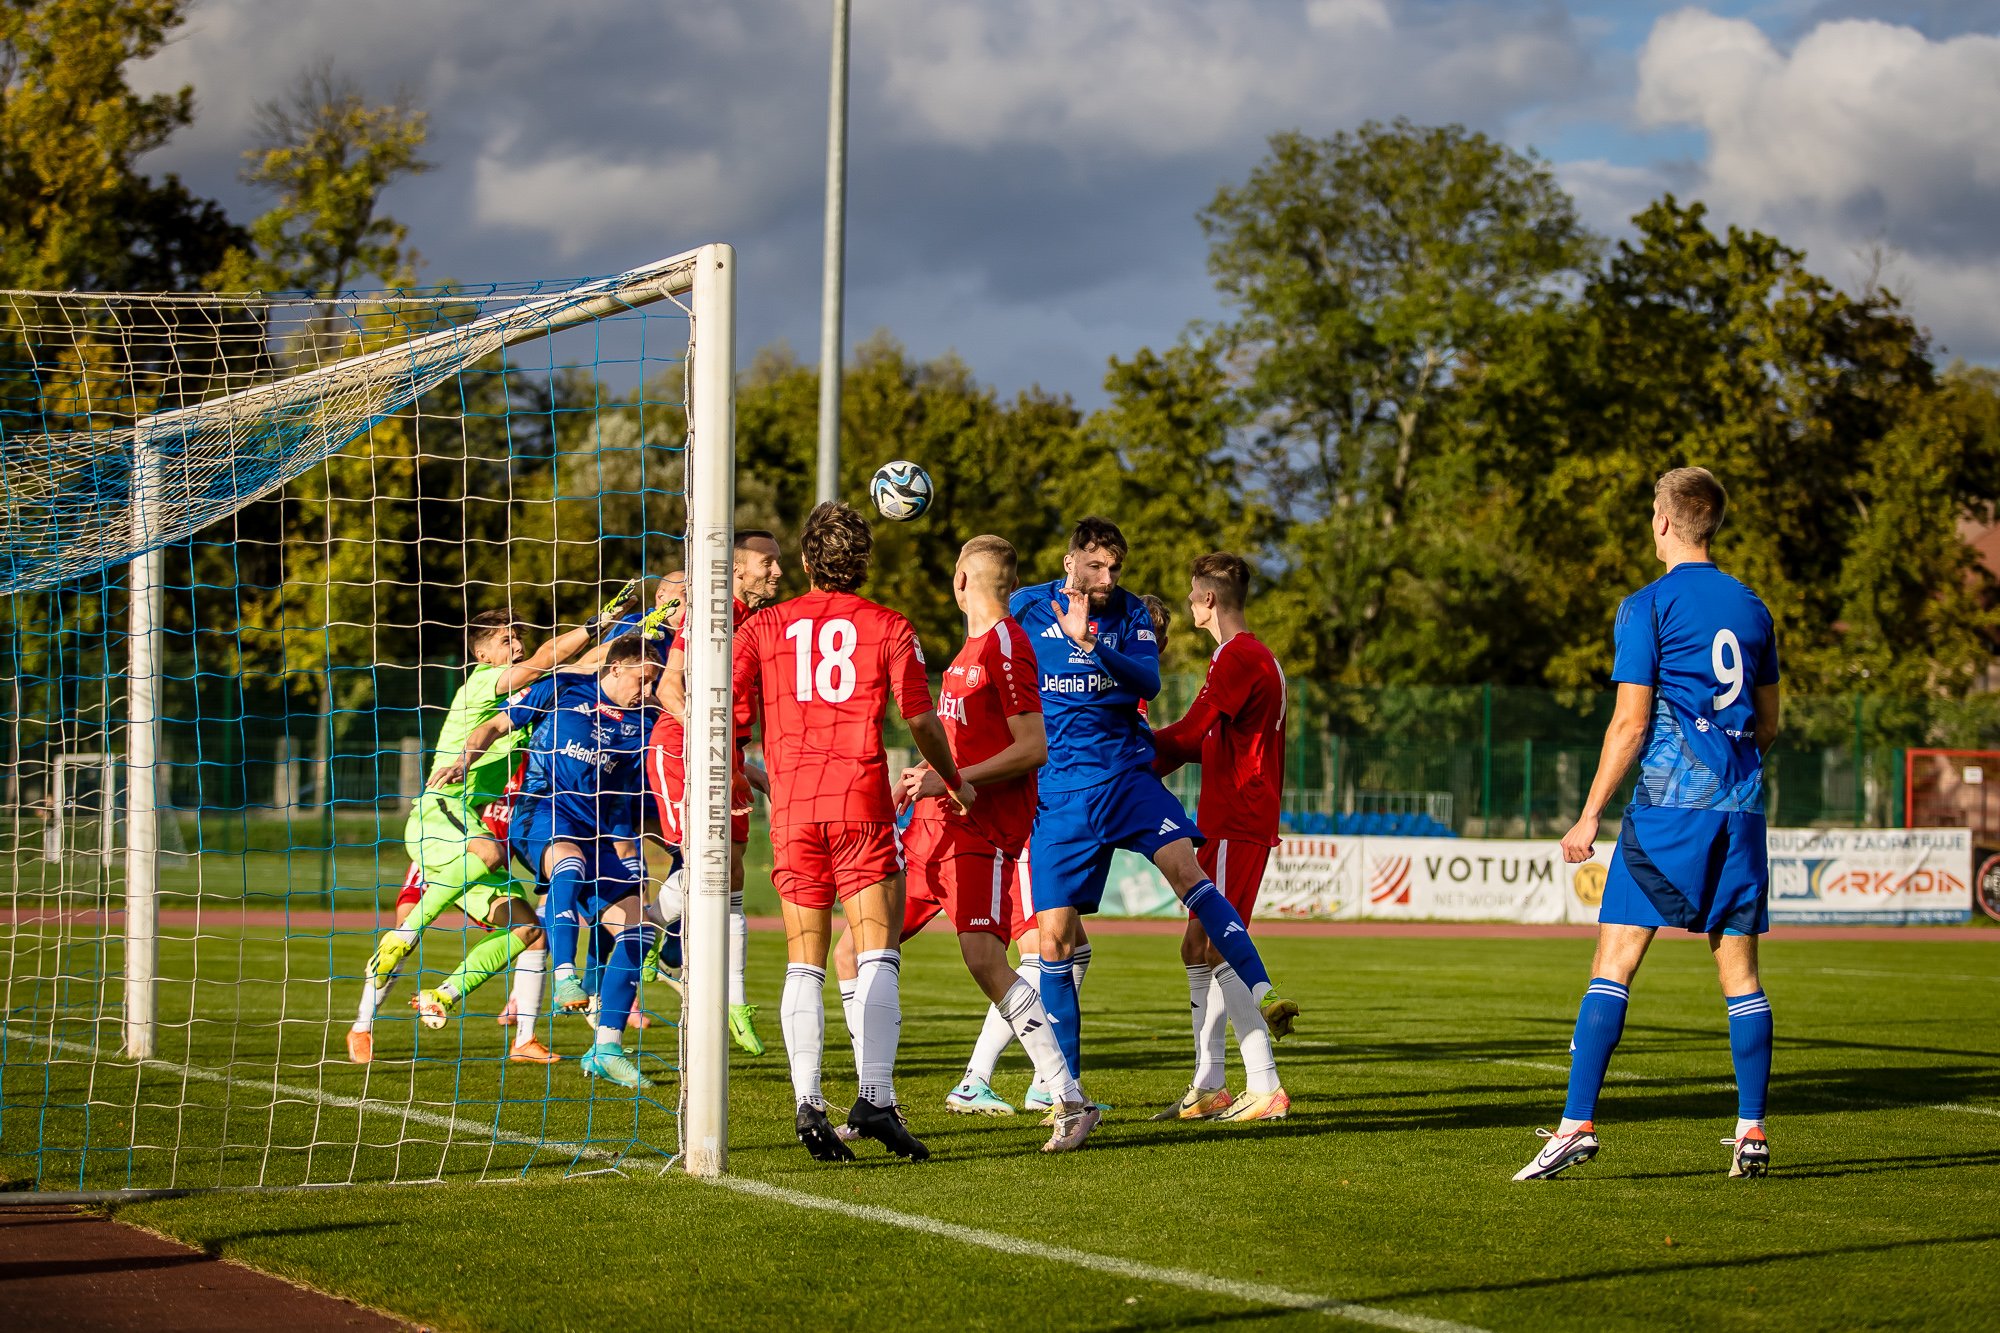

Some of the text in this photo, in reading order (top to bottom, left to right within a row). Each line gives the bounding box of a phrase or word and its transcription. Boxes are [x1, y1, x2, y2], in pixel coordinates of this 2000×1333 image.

[785, 618, 857, 703] 18
[1712, 629, 1743, 711] 9
[1041, 674, 1085, 692] Jelenia
[709, 560, 728, 840] SPORT TRANSFER
[560, 739, 598, 766] Jelenia
[1769, 834, 1847, 850] BUDOWY
[1425, 857, 1553, 882] VOTUM
[1827, 869, 1966, 896] ARKADIA
